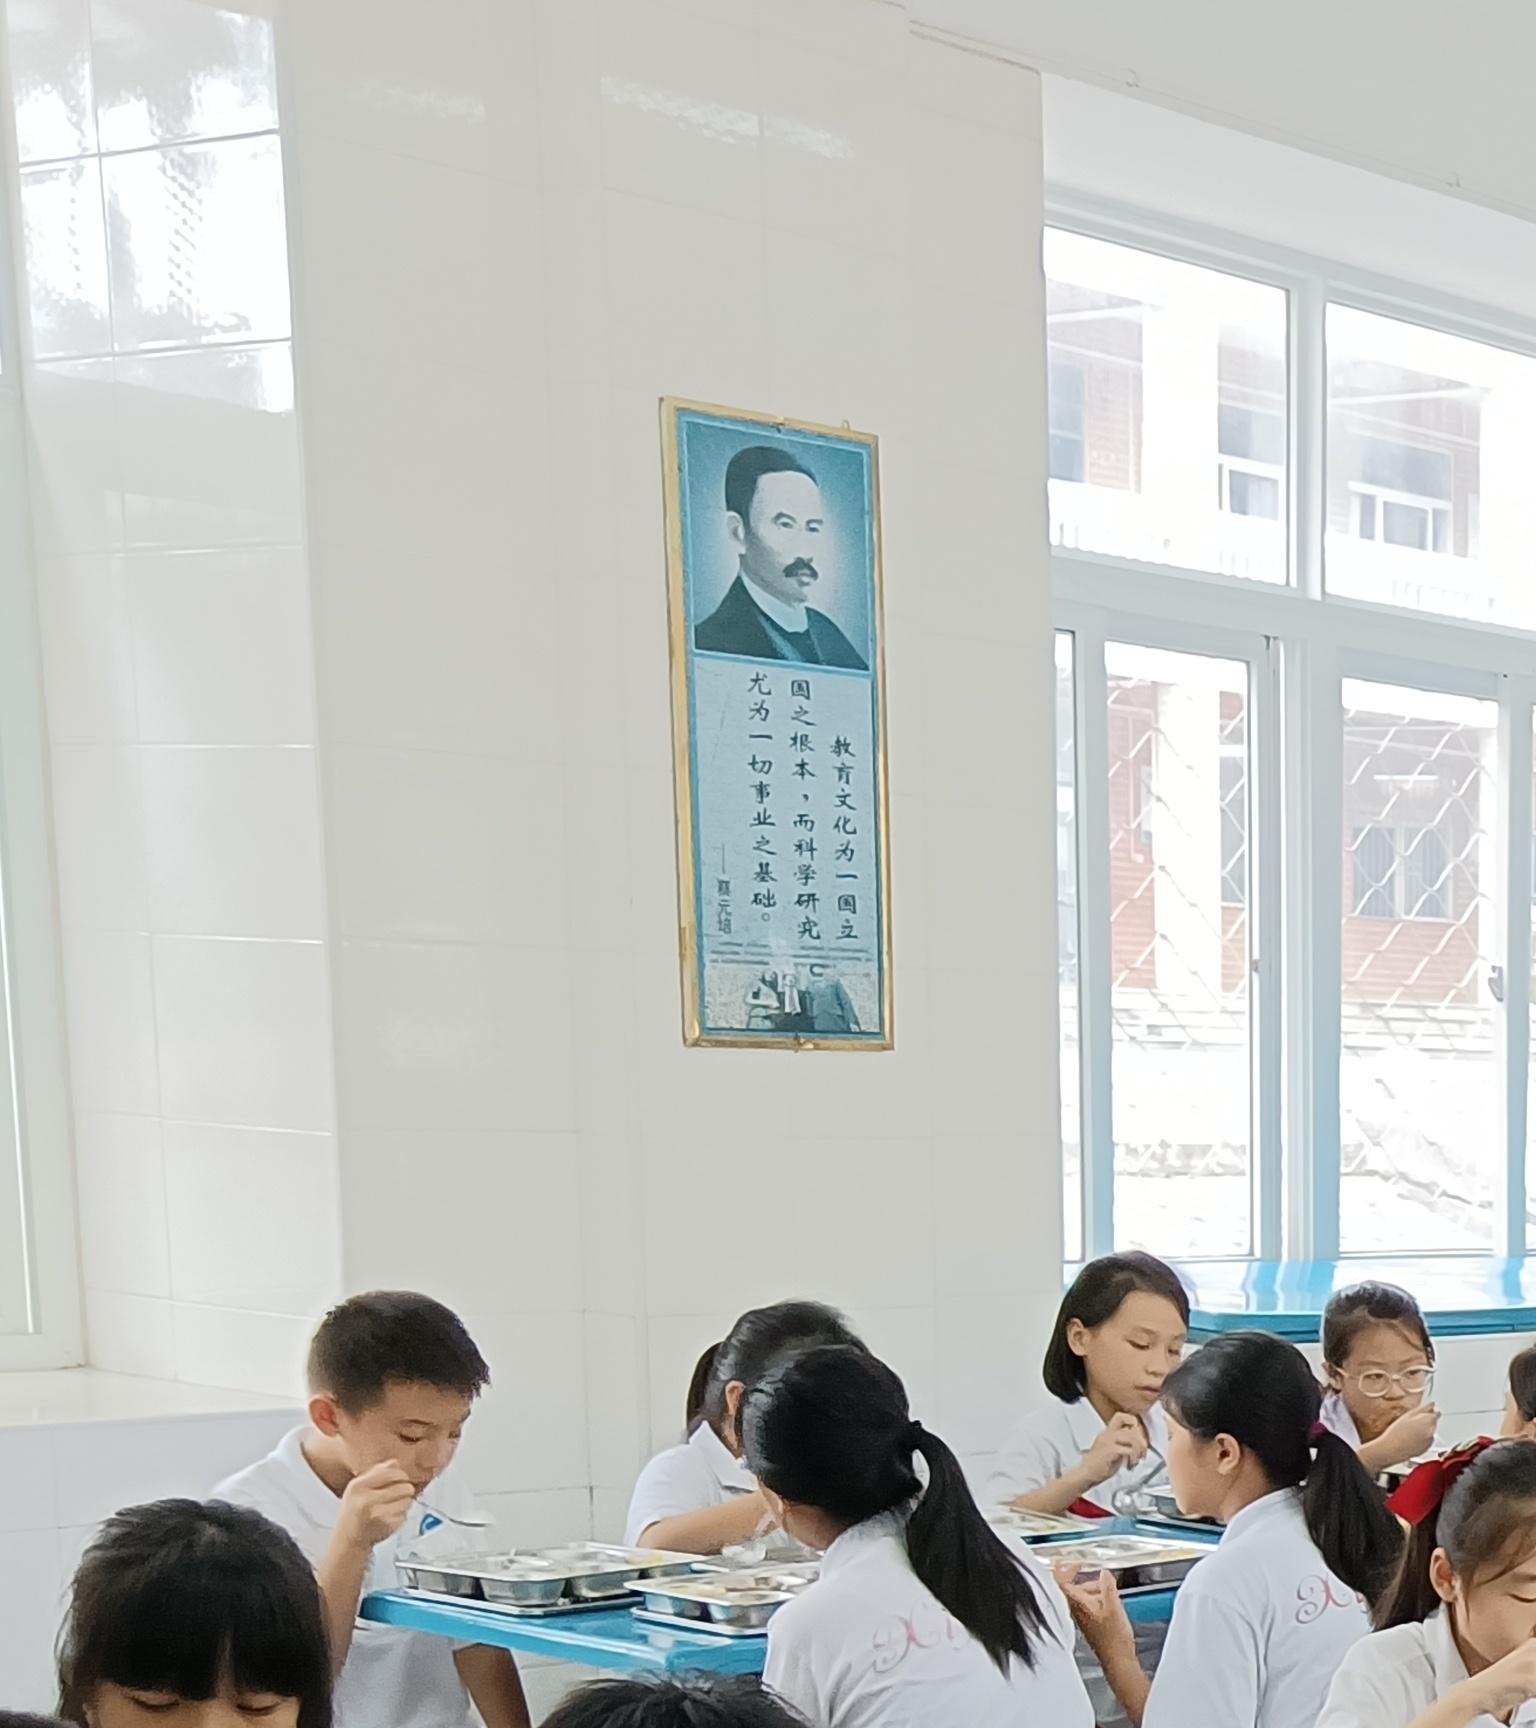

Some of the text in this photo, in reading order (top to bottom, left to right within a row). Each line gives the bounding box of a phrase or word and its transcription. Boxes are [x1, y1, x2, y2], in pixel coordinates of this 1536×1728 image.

[747, 671, 777, 922] 尤为一切事业之基础。
[789, 678, 821, 941] 国之根本，而科学研究
[829, 735, 859, 941] 教育文化为一国立
